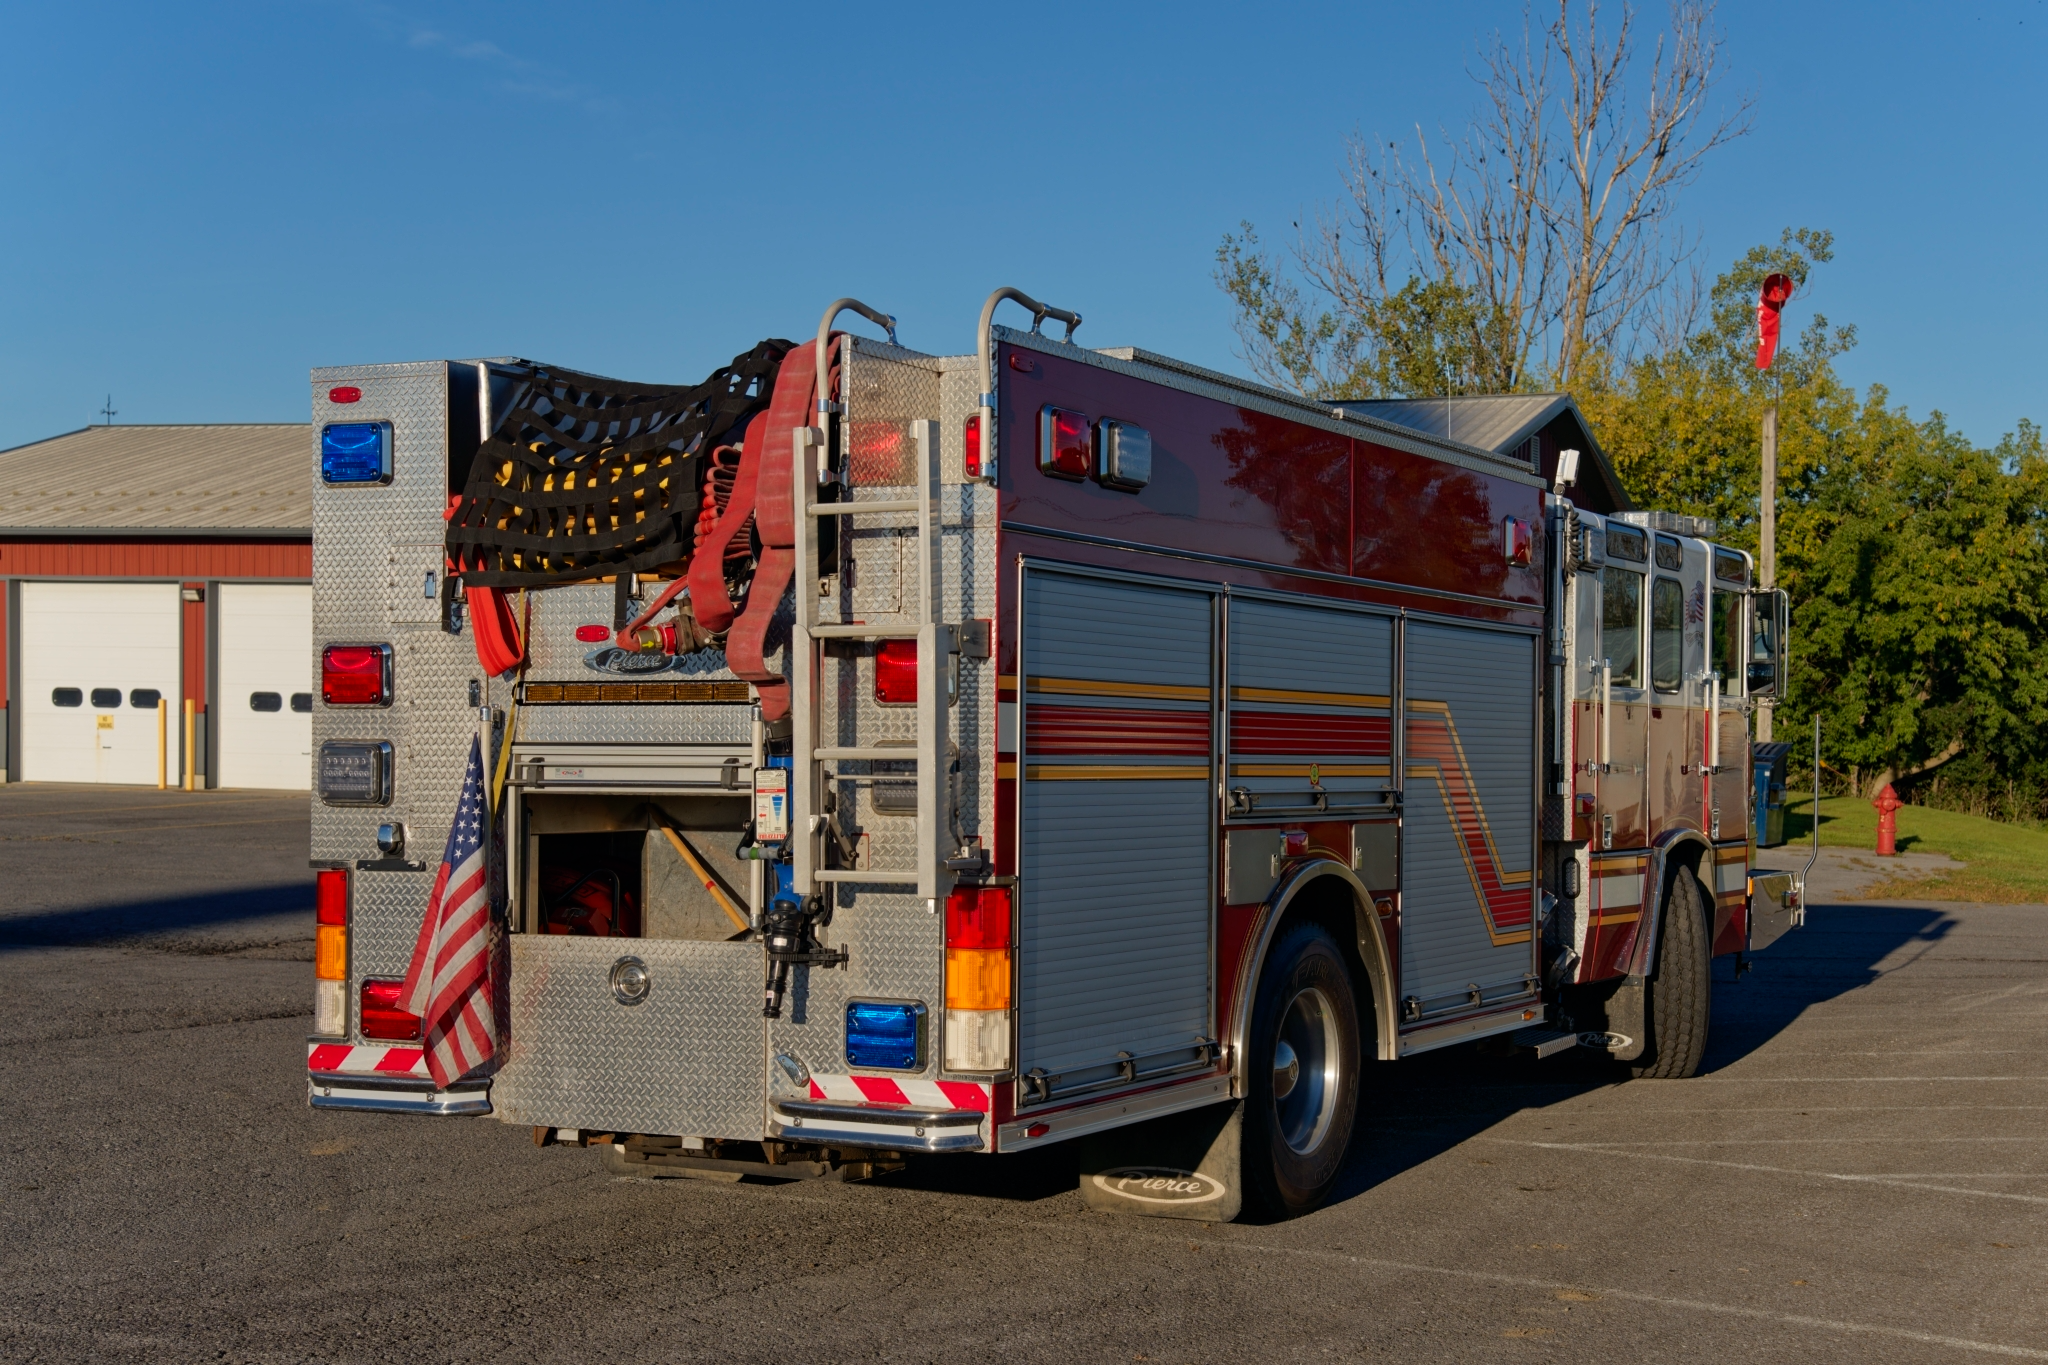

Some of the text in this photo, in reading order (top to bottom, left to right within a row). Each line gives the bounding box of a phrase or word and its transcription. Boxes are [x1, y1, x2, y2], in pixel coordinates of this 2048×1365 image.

[604, 648, 662, 671] Pierce
[1584, 1033, 1618, 1045] Pierce
[1117, 1171, 1202, 1193] Pierce
